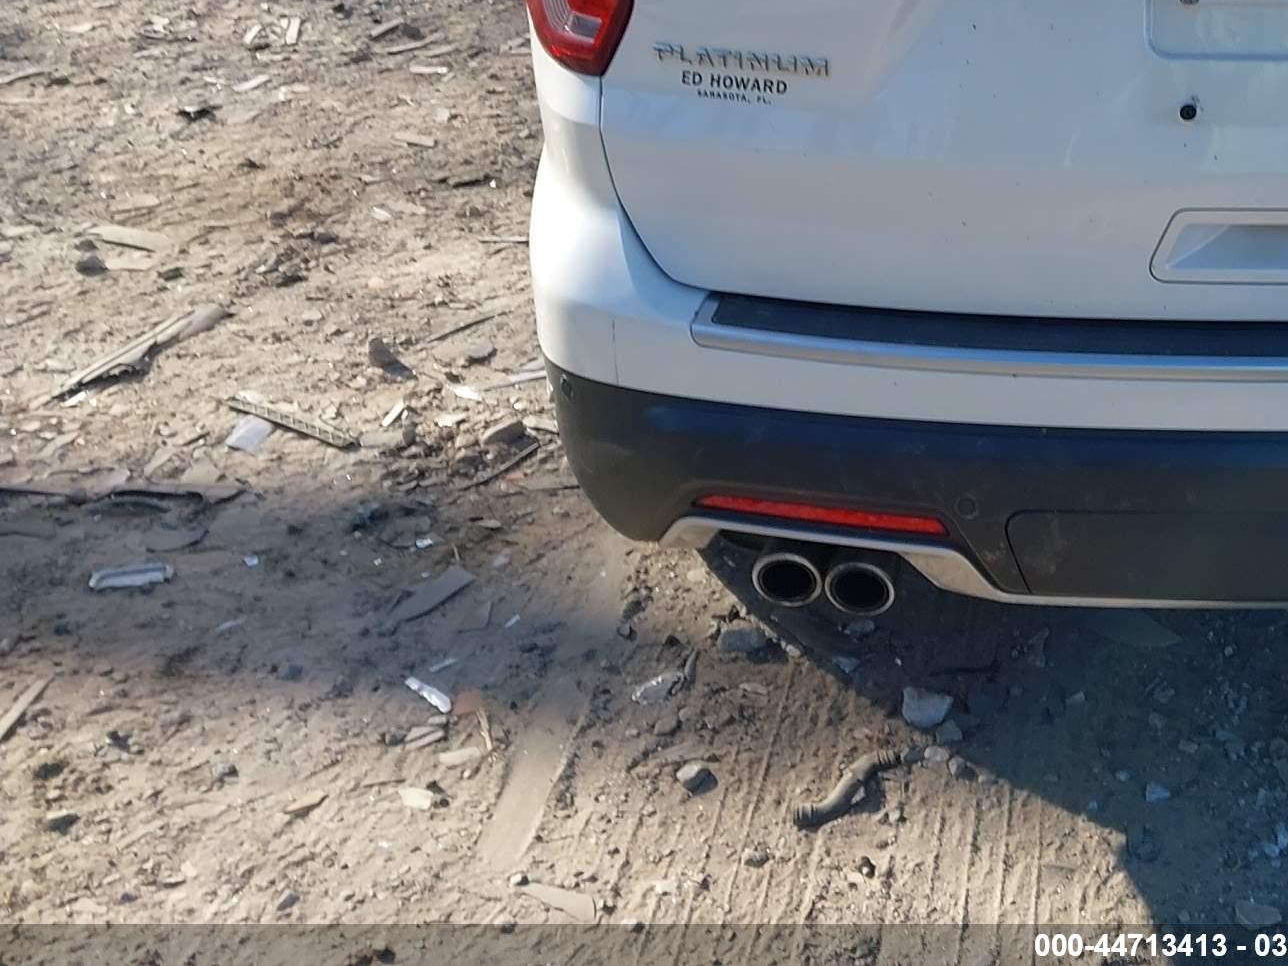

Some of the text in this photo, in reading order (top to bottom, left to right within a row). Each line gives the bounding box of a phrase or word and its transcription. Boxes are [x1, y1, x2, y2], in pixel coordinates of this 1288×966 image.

[652, 42, 831, 78] PLATINUM
[682, 70, 788, 95] ED HOWARD
